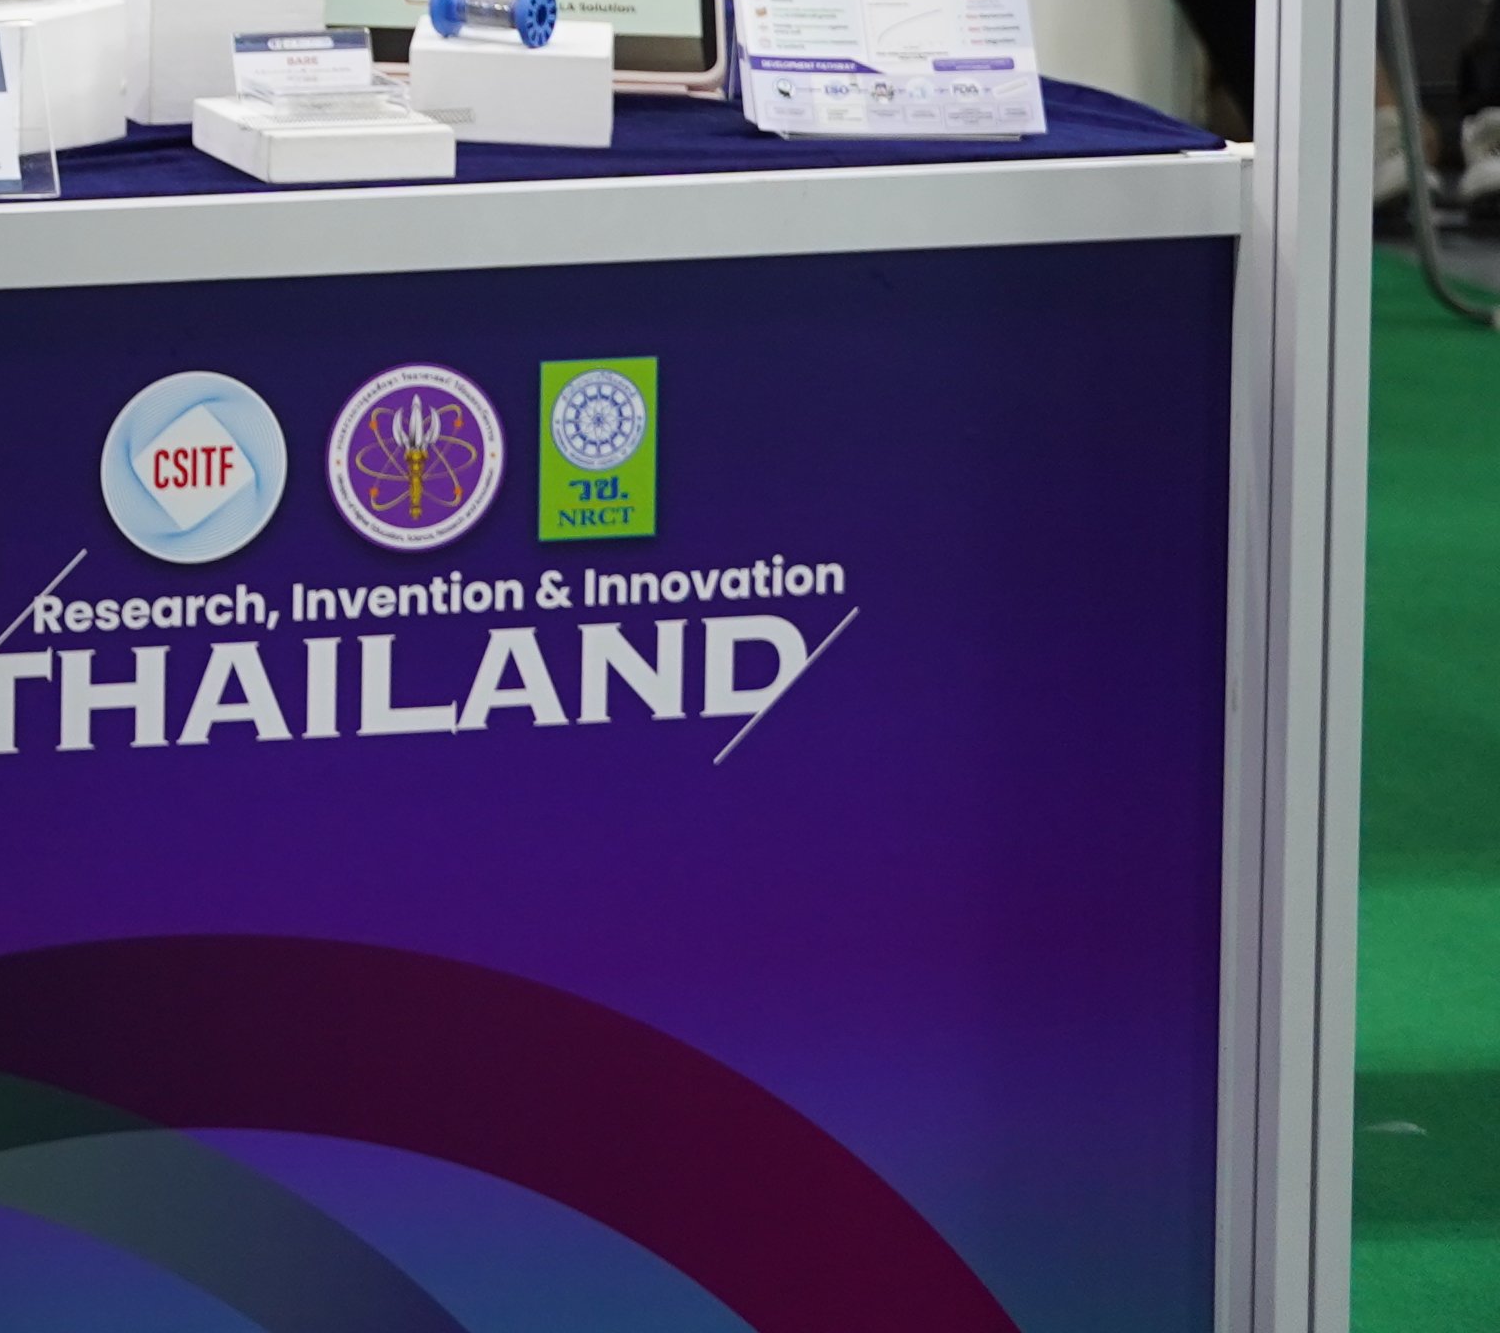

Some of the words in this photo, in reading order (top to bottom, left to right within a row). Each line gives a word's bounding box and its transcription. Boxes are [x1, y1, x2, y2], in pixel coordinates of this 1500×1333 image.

[151, 443, 235, 492] CSITF
[568, 475, 629, 501] วช.
[557, 506, 636, 527] NRCT
[33, 582, 280, 635] Research,
[293, 573, 526, 623] Invention
[534, 571, 573, 609] &
[584, 557, 846, 607] Innovation
